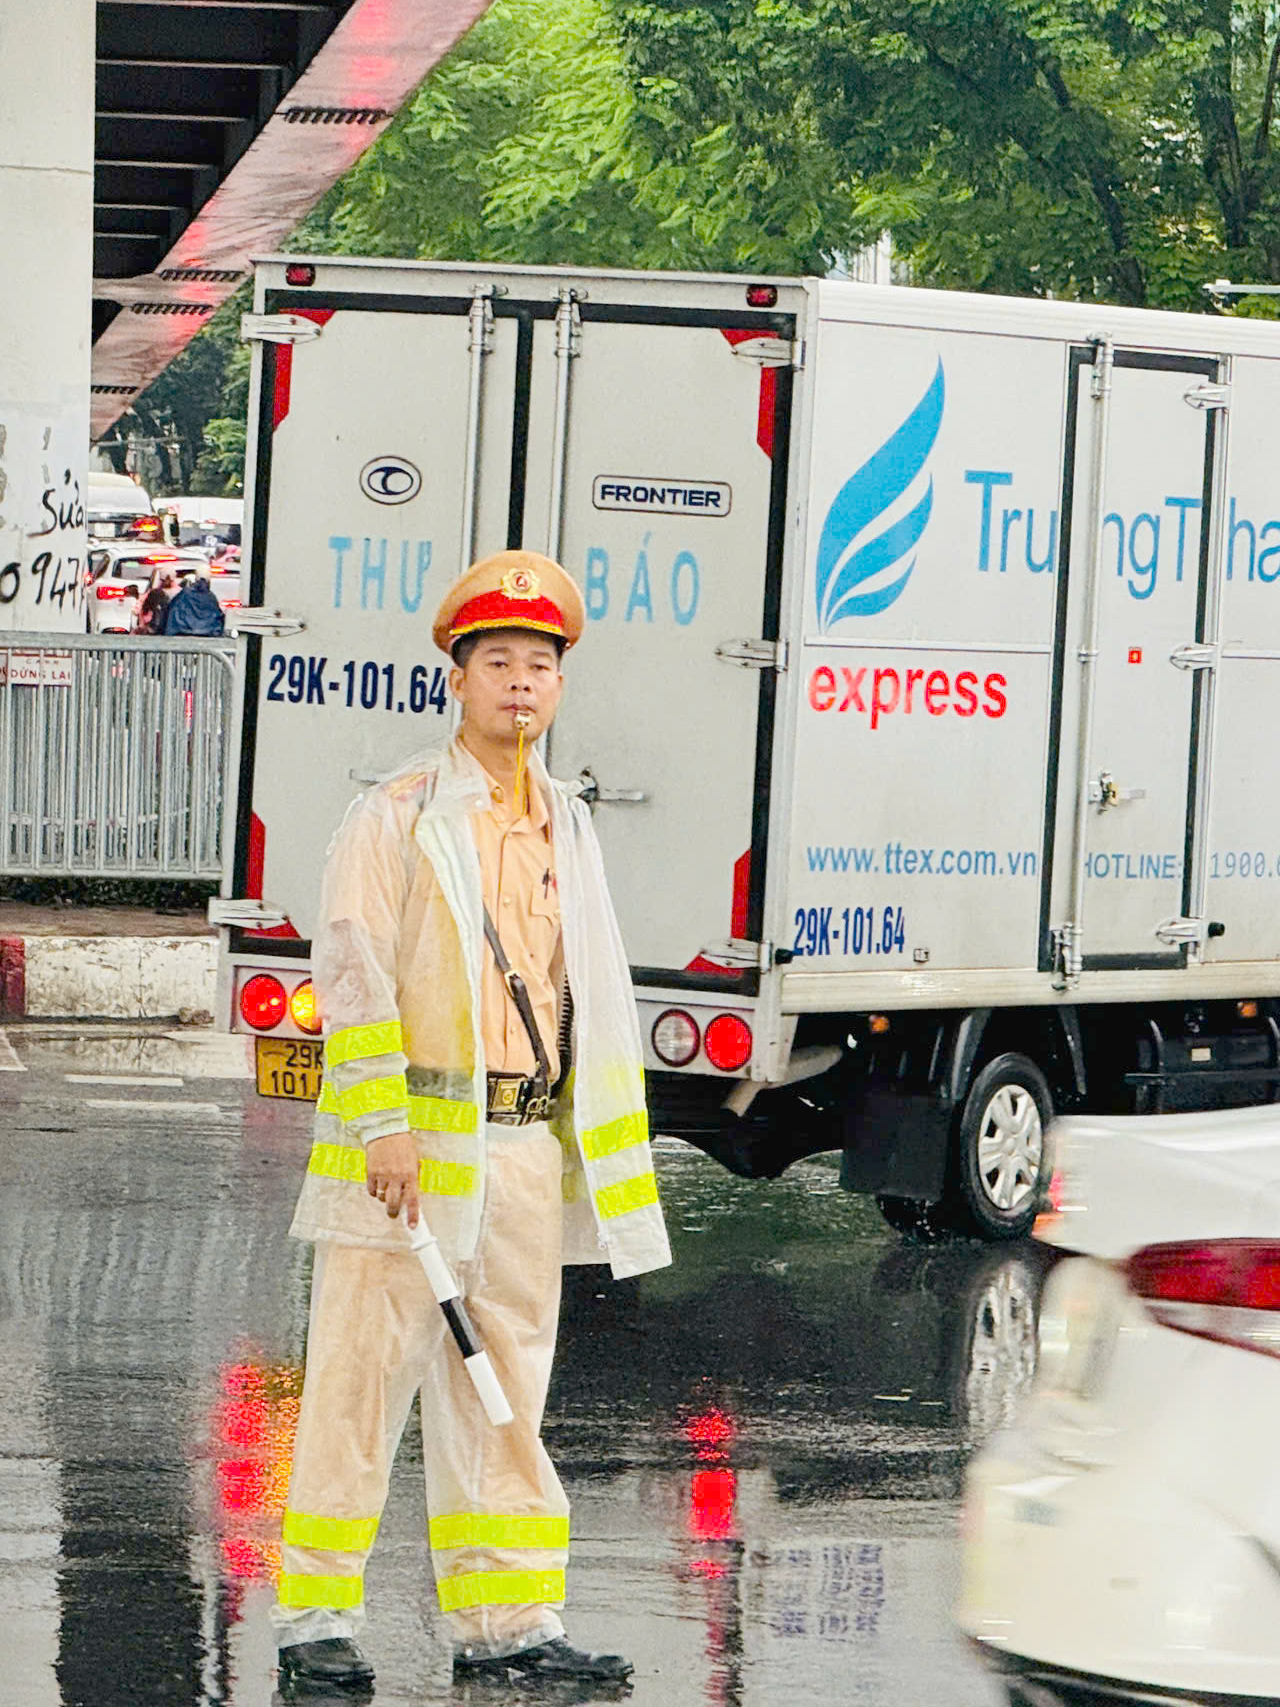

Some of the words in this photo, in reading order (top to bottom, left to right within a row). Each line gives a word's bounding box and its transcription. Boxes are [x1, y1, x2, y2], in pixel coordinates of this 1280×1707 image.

[600, 484, 722, 509] FRONTIER
[328, 534, 432, 613] THƯ
[585, 530, 700, 625] BÁO
[266, 654, 447, 715] 29K-101.64
[807, 664, 1009, 730] express
[806, 842, 1038, 878] www.ttex.com.vn
[793, 905, 906, 957] 29K-101.64
